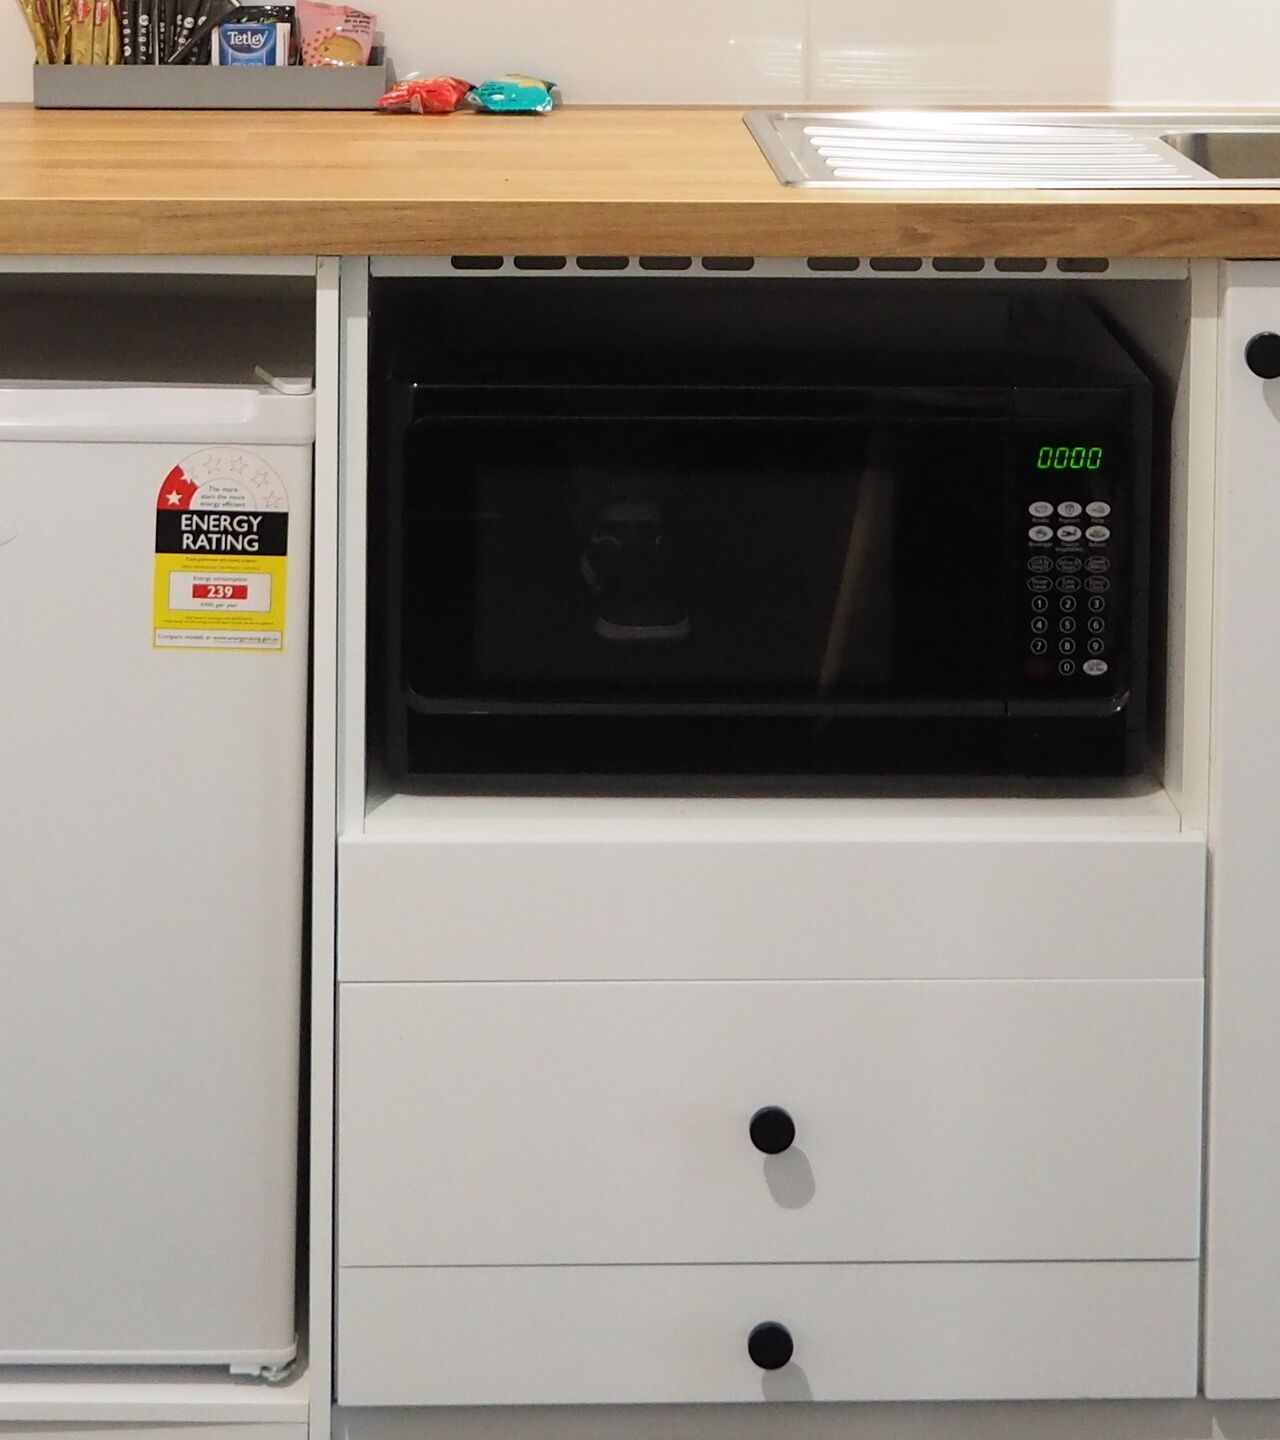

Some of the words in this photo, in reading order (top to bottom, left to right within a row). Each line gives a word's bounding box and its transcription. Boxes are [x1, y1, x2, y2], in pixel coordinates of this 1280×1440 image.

[227, 30, 269, 48] Tetley
[1036, 446, 1102, 469] 0000
[180, 514, 263, 533] ENERGY
[182, 533, 259, 551] RATING
[206, 585, 233, 597] 239
